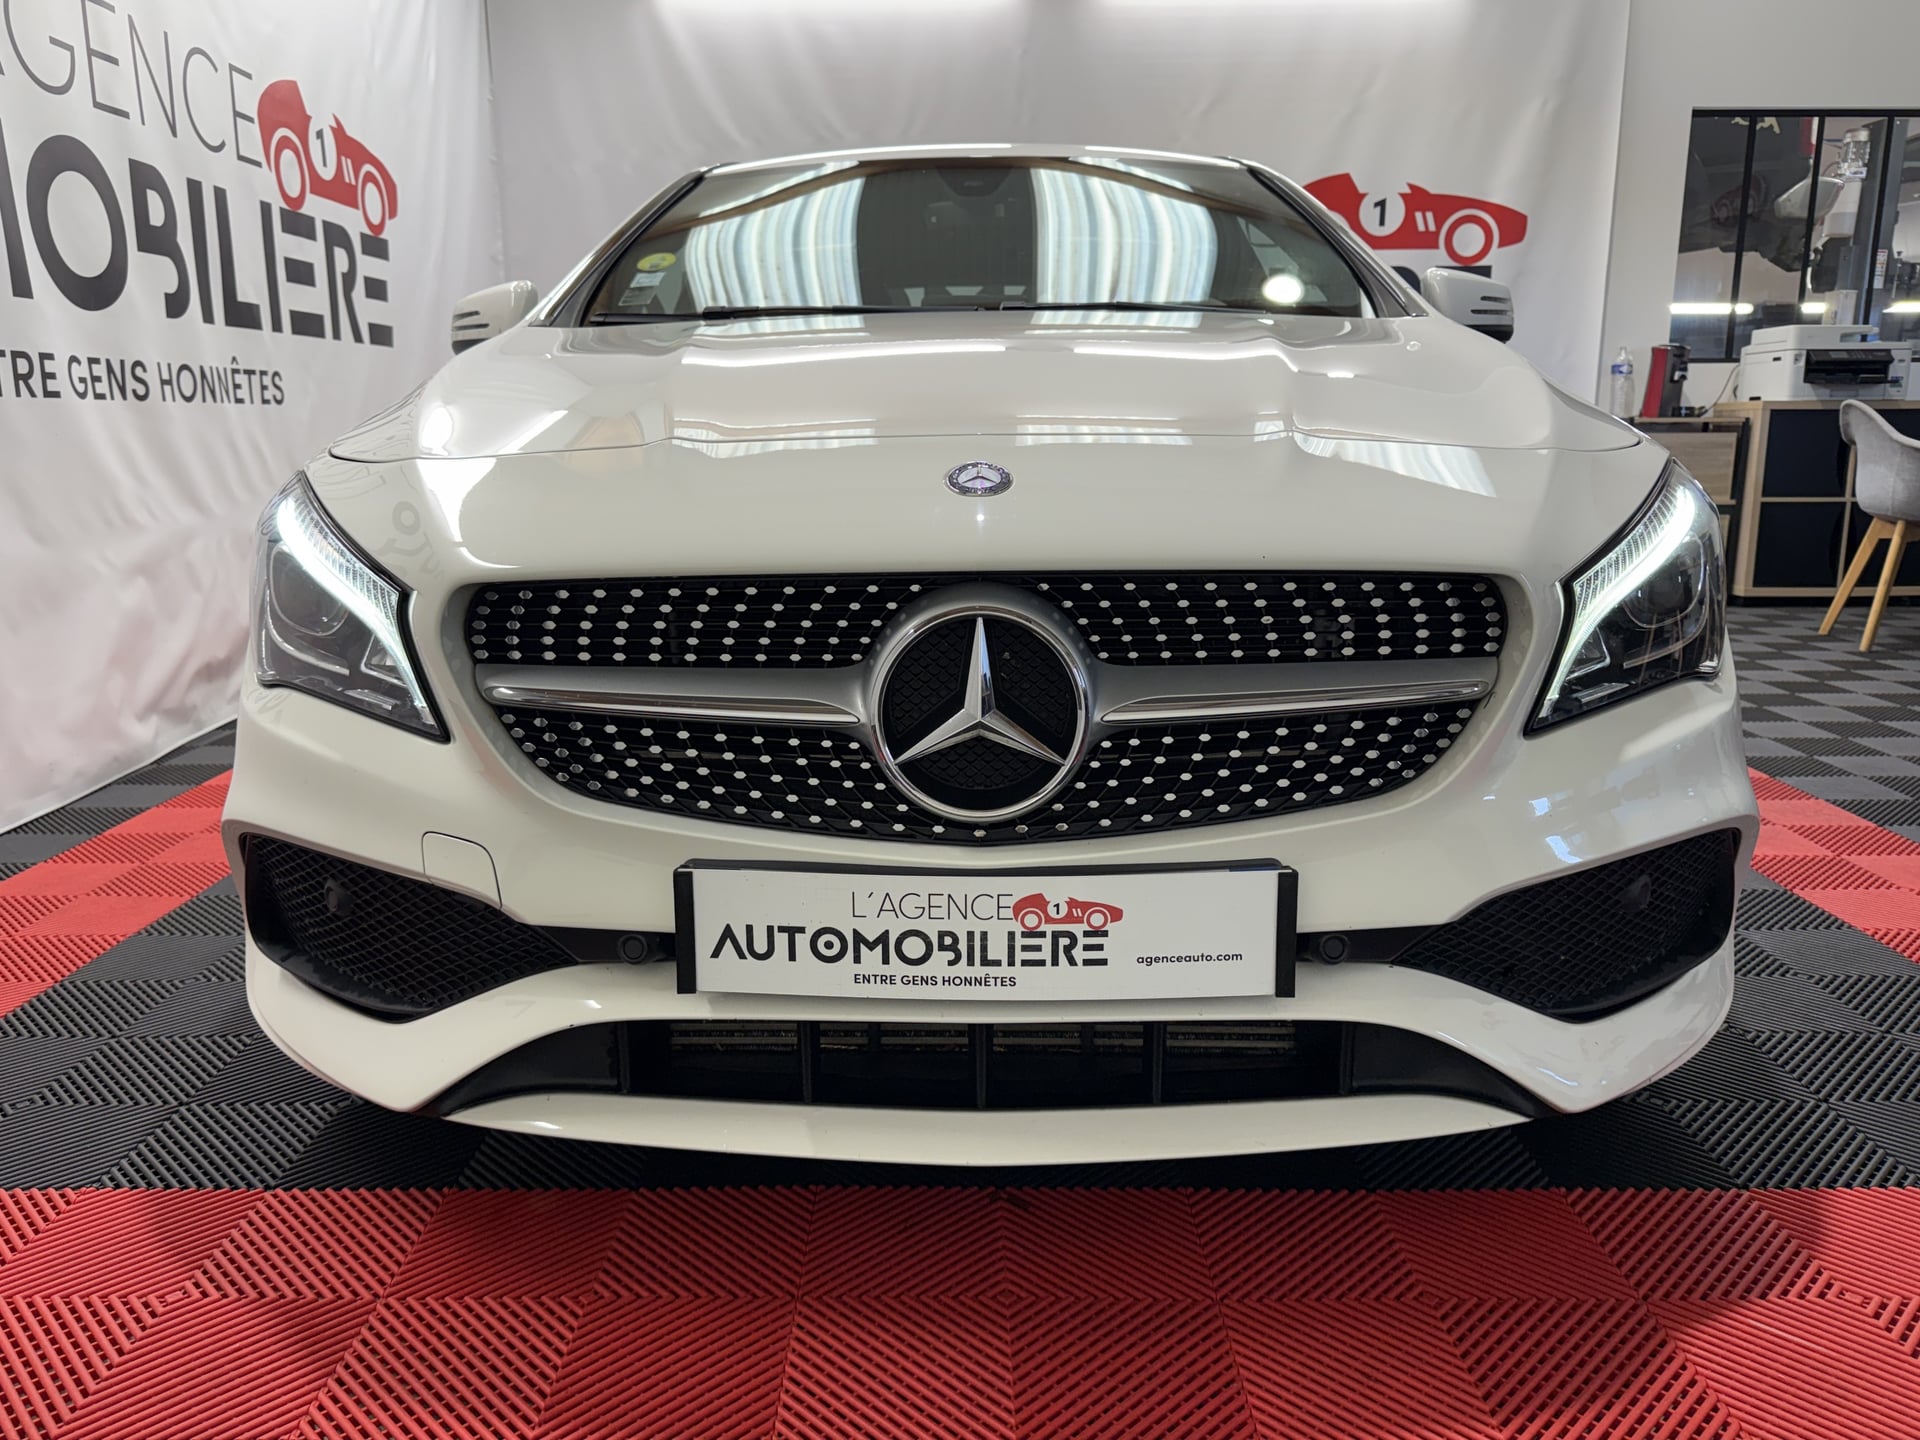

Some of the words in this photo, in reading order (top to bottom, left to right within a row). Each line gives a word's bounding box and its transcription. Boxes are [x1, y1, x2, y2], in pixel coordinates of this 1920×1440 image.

[0, 0, 262, 168] GENCE
[316, 128, 327, 168] 1
[1373, 197, 1387, 227] 1
[67, 355, 150, 401] GENS
[157, 355, 285, 405] HONNÊTES
[852, 891, 1014, 921] L'AGENCE
[1053, 903, 1060, 915] 1
[1136, 952, 1243, 967] agenceauto.com
[854, 973, 897, 986] ENTRE
[900, 974, 938, 986] GENS
[942, 973, 1017, 987] HONNÊTES
